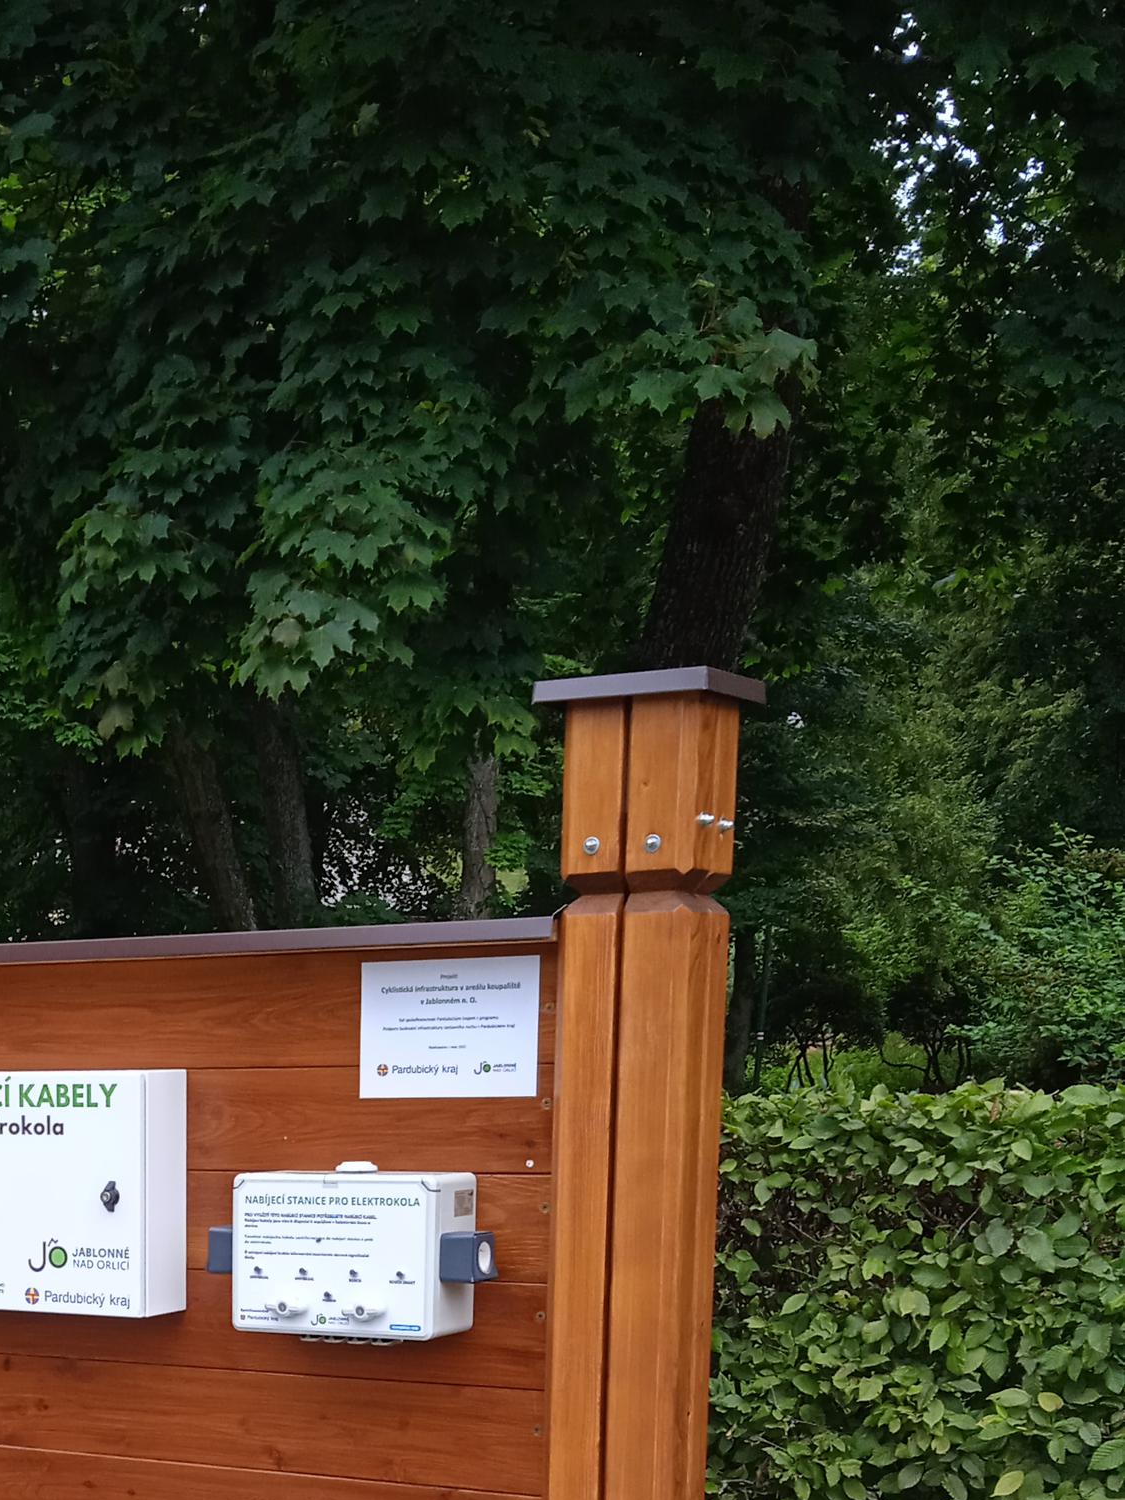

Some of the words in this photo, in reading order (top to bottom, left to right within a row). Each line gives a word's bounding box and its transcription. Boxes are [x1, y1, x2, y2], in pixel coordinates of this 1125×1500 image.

[392, 1064, 439, 1076] Pardubický
[442, 1063, 458, 1075] kraj
[18, 1082, 118, 1108] KABELY
[244, 1194, 285, 1206] NABÍJECÍ
[287, 1196, 326, 1206] STANICE
[328, 1196, 349, 1206] PRO
[351, 1197, 421, 1207] ELEKTROKOLA
[72, 1246, 130, 1259] JABLONNÉ
[72, 1259, 94, 1269] NAD
[44, 1290, 105, 1308] Pardubický
[109, 1294, 131, 1310] kraj
